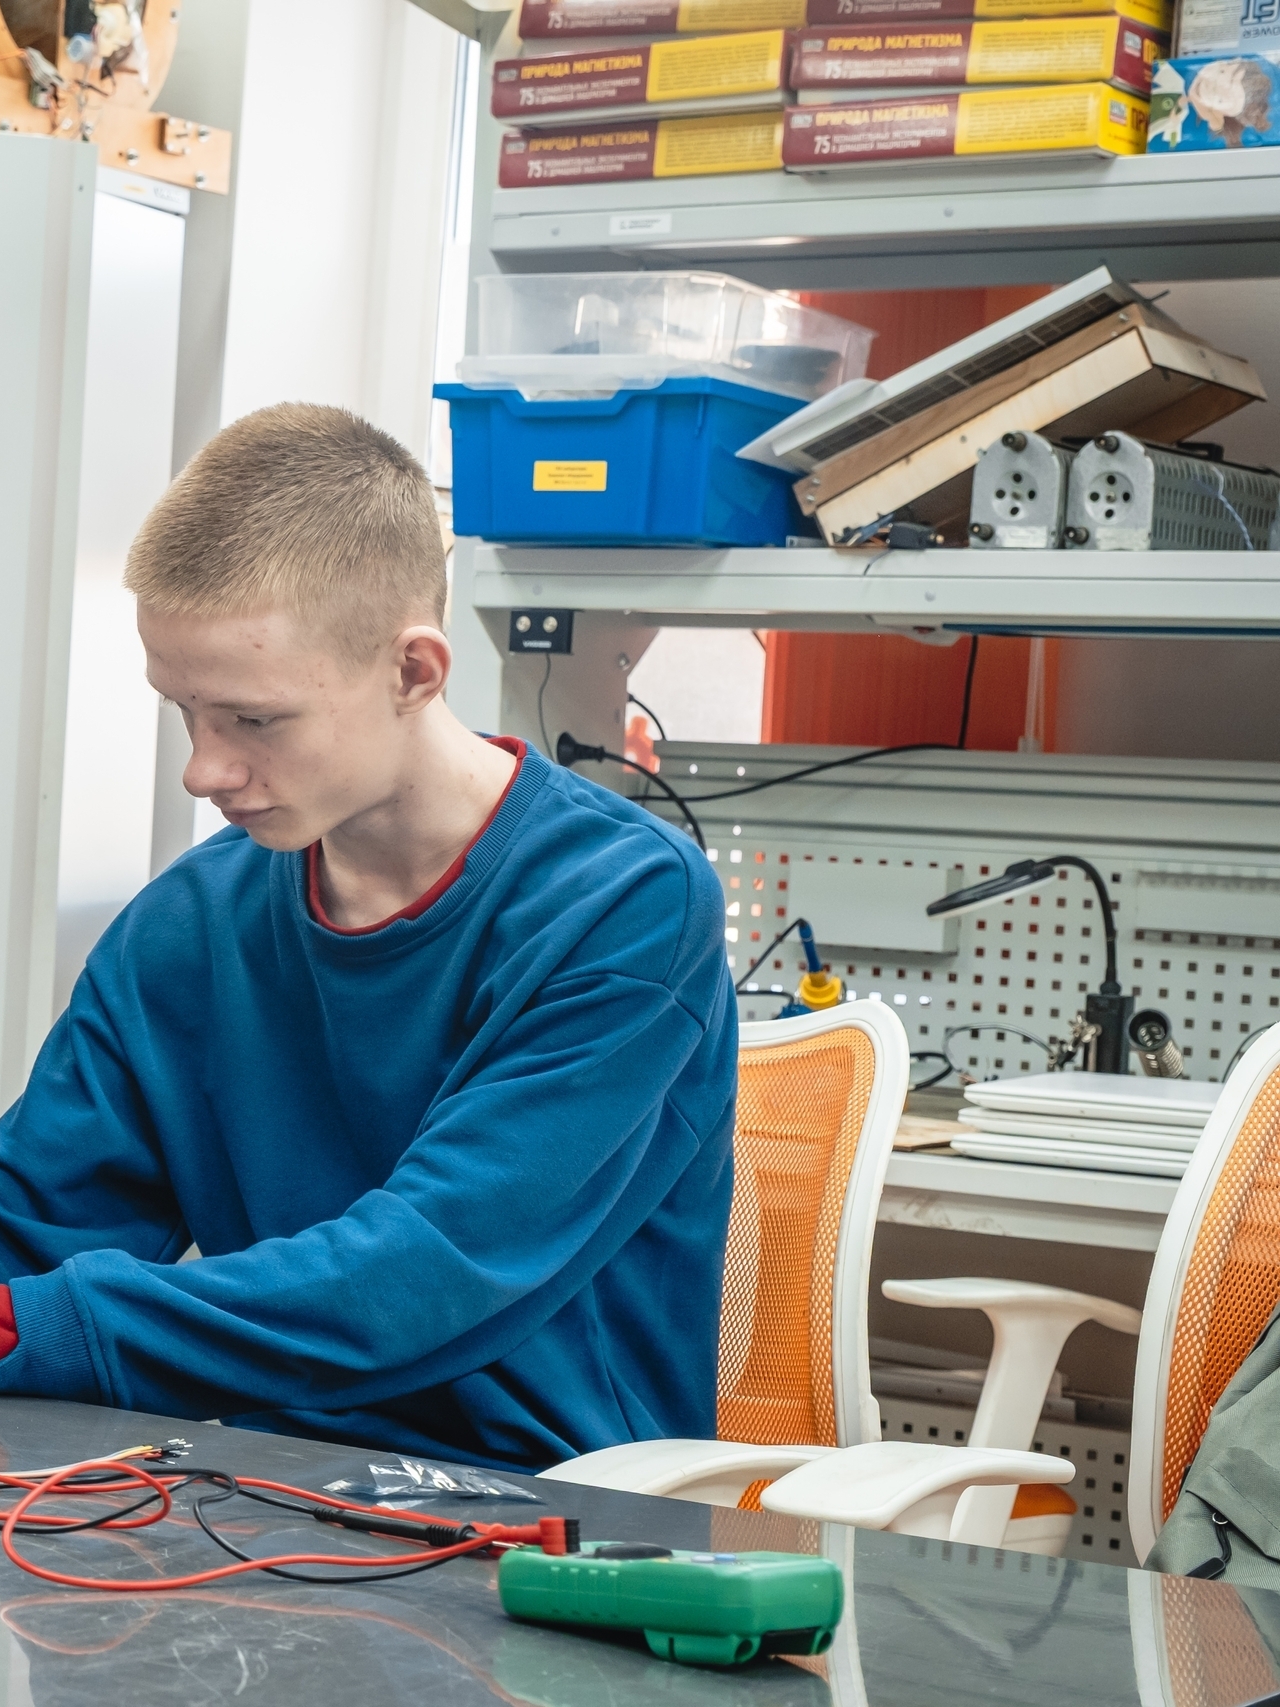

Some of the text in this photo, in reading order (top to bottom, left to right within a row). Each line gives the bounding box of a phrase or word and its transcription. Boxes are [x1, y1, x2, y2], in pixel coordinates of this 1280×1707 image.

[828, 37, 881, 51] ПРИРОДА
[885, 33, 962, 49] МАГНЕТИЗМА
[521, 63, 570, 78] ПРИРОДА
[573, 55, 642, 73] МАГНЕТИЗМА
[824, 59, 842, 79] 75
[520, 87, 535, 106] 75
[816, 110, 869, 126] ПРИРОДА
[872, 104, 948, 122] МАГНЕТИЗМА
[529, 137, 577, 151] ПРИРОДА
[581, 131, 649, 147] МАГНЕТИЗМА
[814, 135, 831, 155] 75
[527, 160, 542, 179] 75
